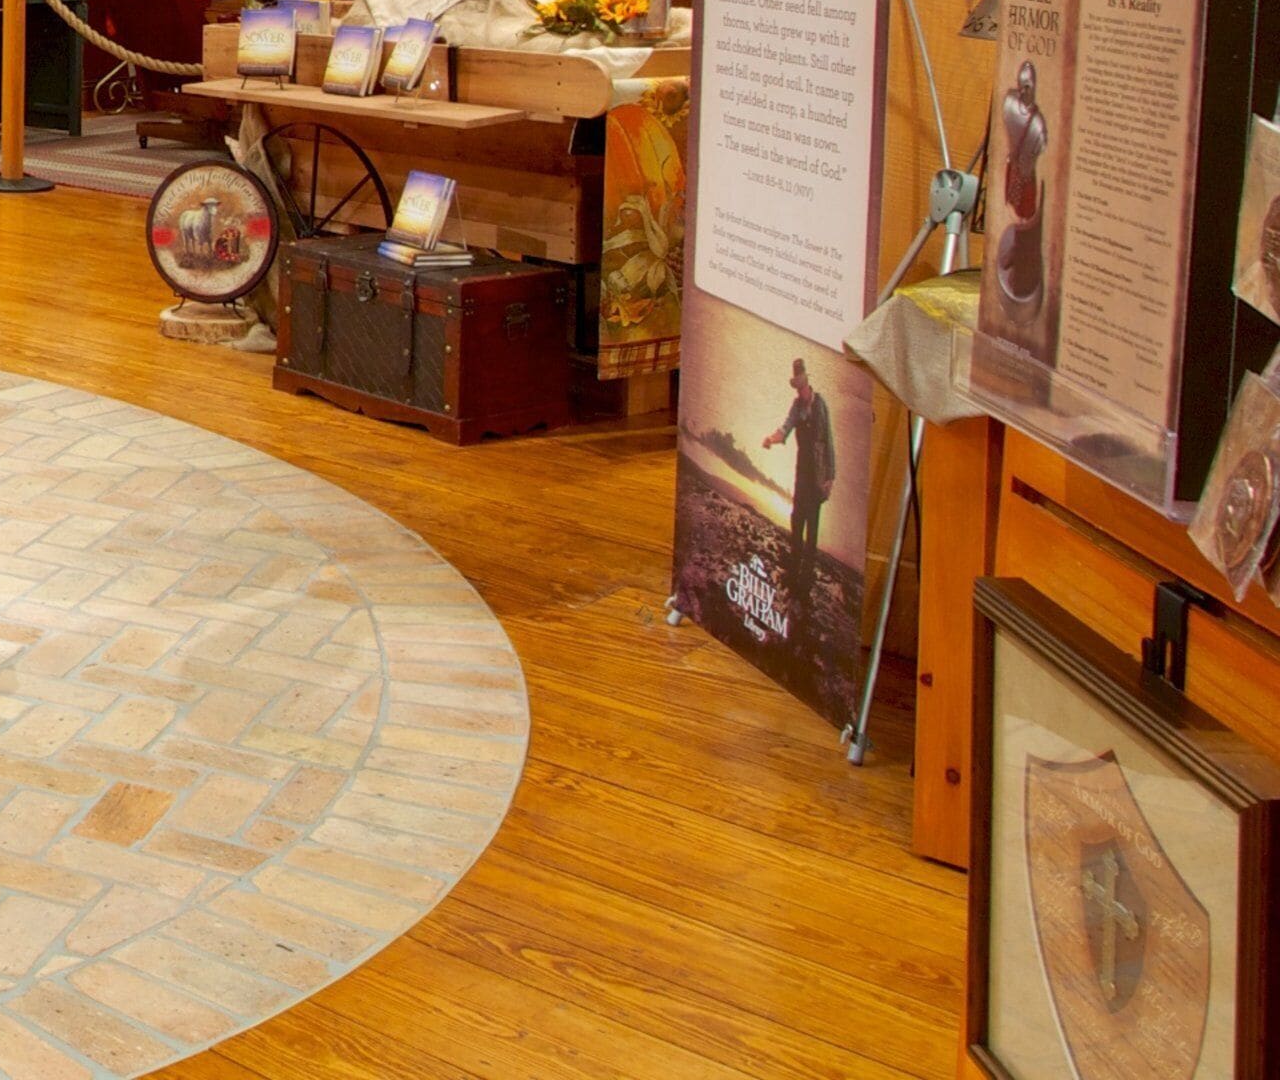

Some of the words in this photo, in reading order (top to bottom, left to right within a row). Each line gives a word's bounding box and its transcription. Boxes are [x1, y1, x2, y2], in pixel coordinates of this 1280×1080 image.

[785, 0, 805, 15] seed
[808, 0, 821, 16] fell
[824, 6, 856, 25] among
[1009, 5, 1060, 35] ARMOR
[754, 16, 779, 35] which
[781, 25, 803, 40] grew
[805, 31, 816, 45] up
[819, 30, 839, 46] with
[842, 32, 850, 48] it
[1008, 32, 1025, 50] OF
[1027, 37, 1056, 58] GOD
[716, 38, 731, 51] and
[733, 41, 762, 58] choked
[764, 43, 777, 60] the
[811, 53, 829, 70] Still
[831, 58, 856, 76] other
[716, 62, 733, 76] seed
[736, 63, 748, 79] fell
[750, 71, 760, 82] on
[763, 72, 783, 87] good
[806, 79, 813, 93] It
[816, 84, 839, 100] came
[842, 91, 854, 106] up
[719, 86, 734, 101] and
[736, 90, 767, 109] yielded
[770, 100, 774, 110] a
[800, 109, 805, 119] a
[808, 103, 847, 129] hundred
[723, 111, 745, 129] times
[748, 121, 770, 135] more
[772, 121, 791, 141] than
[794, 132, 811, 145] was
[725, 135, 739, 151] The
[741, 142, 759, 157] seed
[762, 147, 768, 160] is
[770, 147, 783, 164] the
[786, 155, 807, 171] word
[809, 158, 819, 174] of
[739, 563, 776, 612] BILLY
[726, 578, 788, 638] GRAHAM
